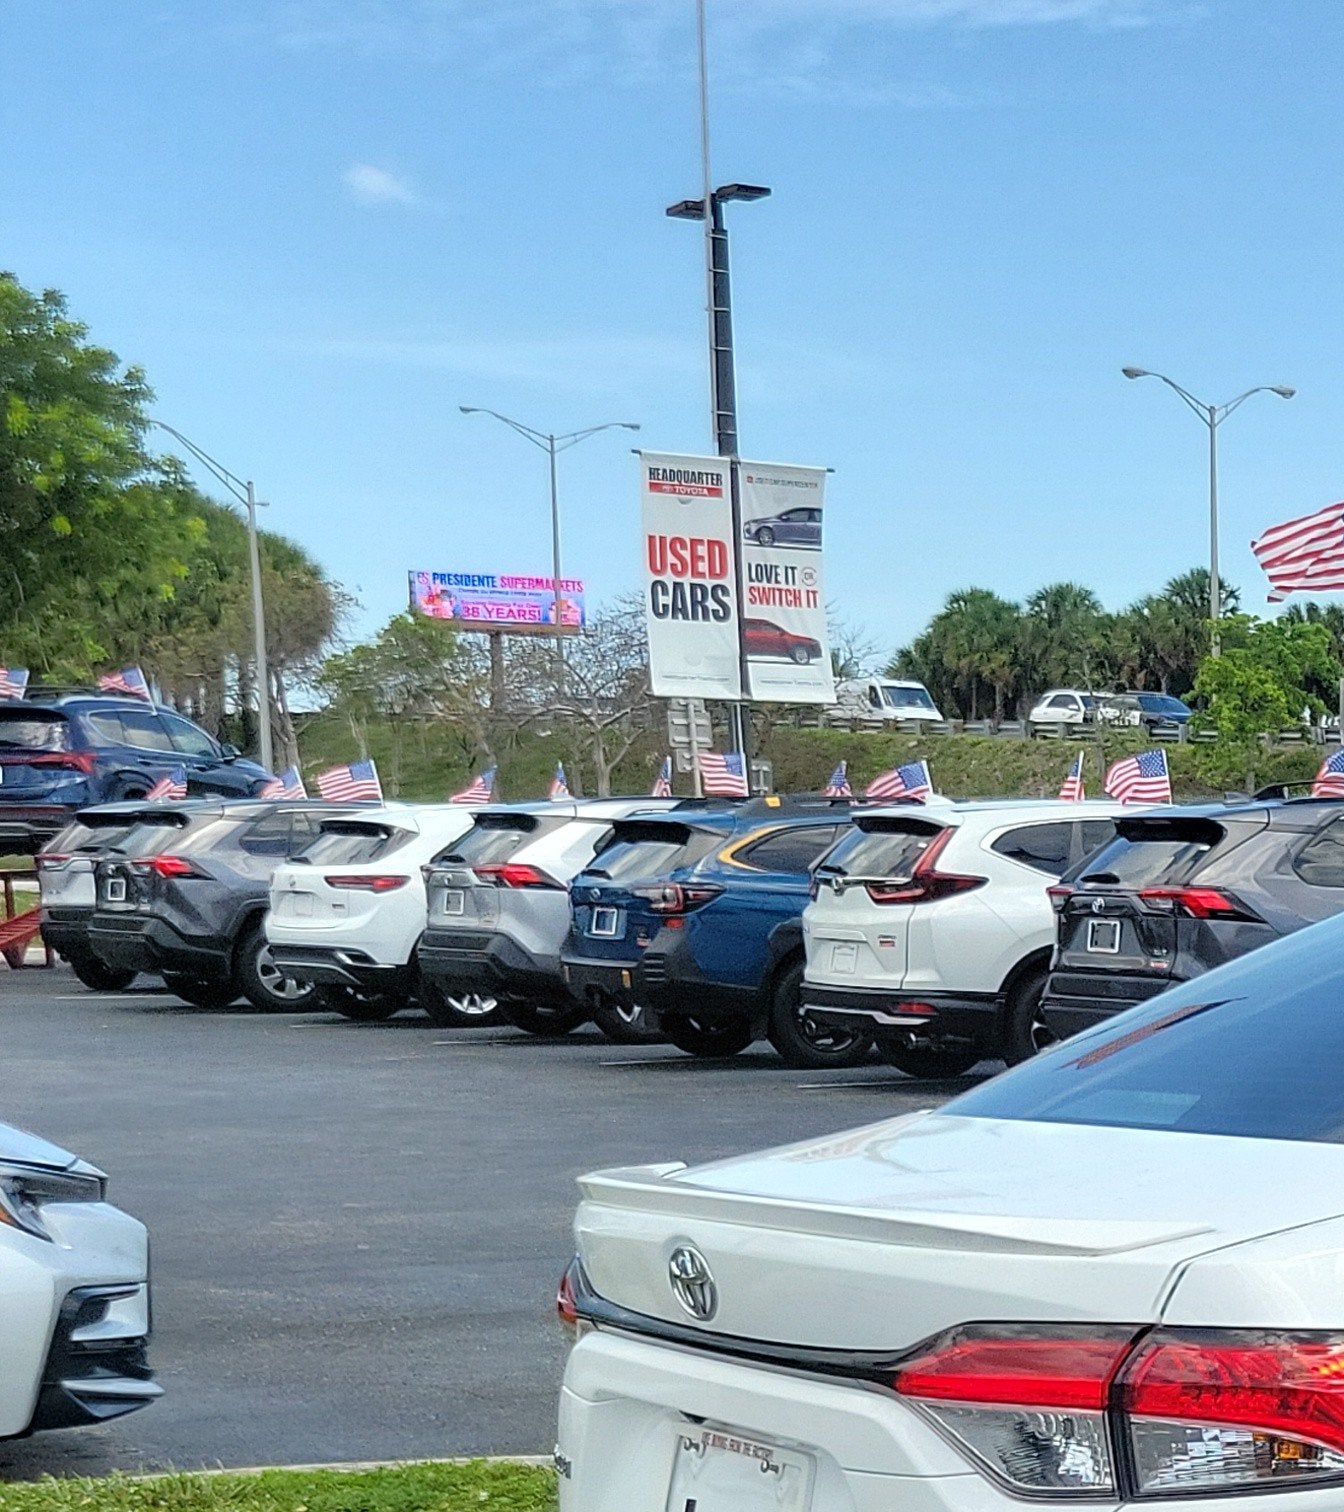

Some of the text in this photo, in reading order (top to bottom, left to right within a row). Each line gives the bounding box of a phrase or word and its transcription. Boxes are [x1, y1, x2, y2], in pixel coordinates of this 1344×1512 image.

[649, 467, 723, 487] HEADQUARTER
[674, 486, 709, 496] TOYOTA
[648, 534, 729, 580] USED
[432, 572, 497, 588] PRESIDENTE
[500, 576, 584, 593] SUPERMAKETS
[747, 562, 782, 584] LOVE
[784, 565, 798, 586] IT
[650, 579, 732, 623] CARS
[748, 585, 818, 609] SWITCH IT
[484, 603, 541, 621] YEARS!
